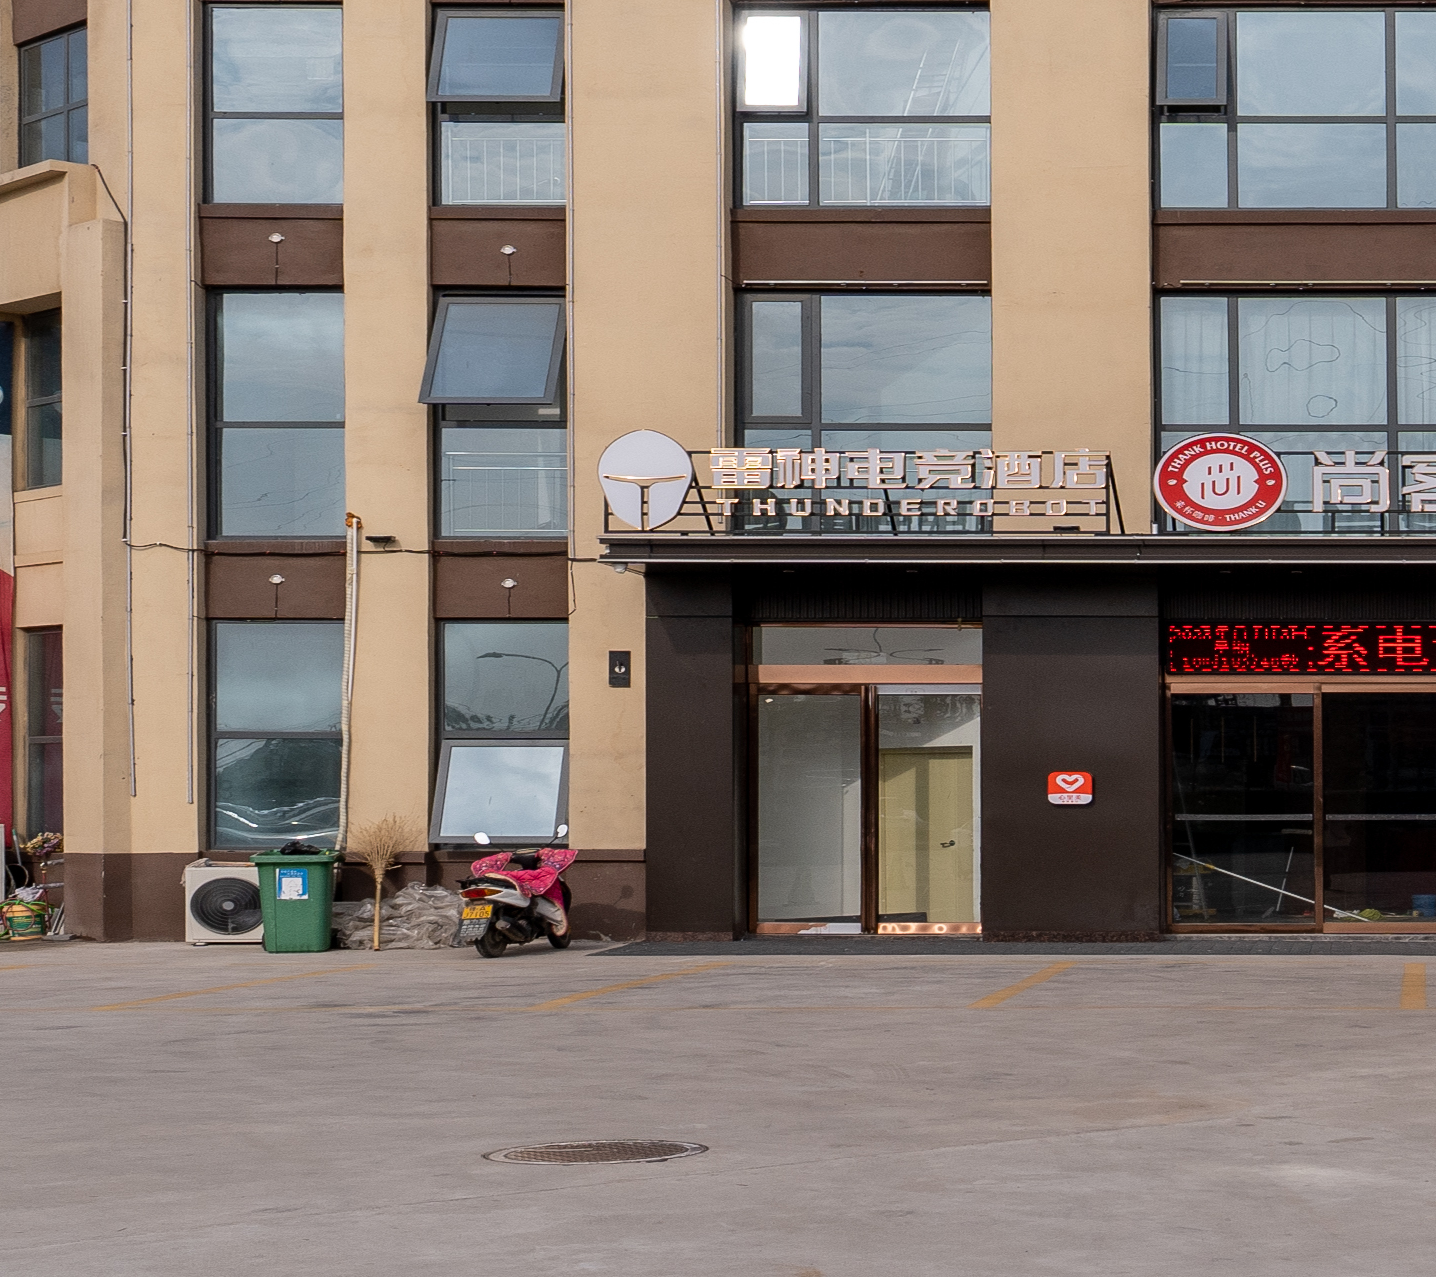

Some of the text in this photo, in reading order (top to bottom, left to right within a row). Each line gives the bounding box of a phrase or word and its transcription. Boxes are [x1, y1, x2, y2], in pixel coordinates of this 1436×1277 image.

[710, 448, 1110, 489] 雷神电竞酒店
[1168, 441, 1275, 475] THANK HOTEL PLUS
[715, 498, 1105, 517] THUNDEROBOT
